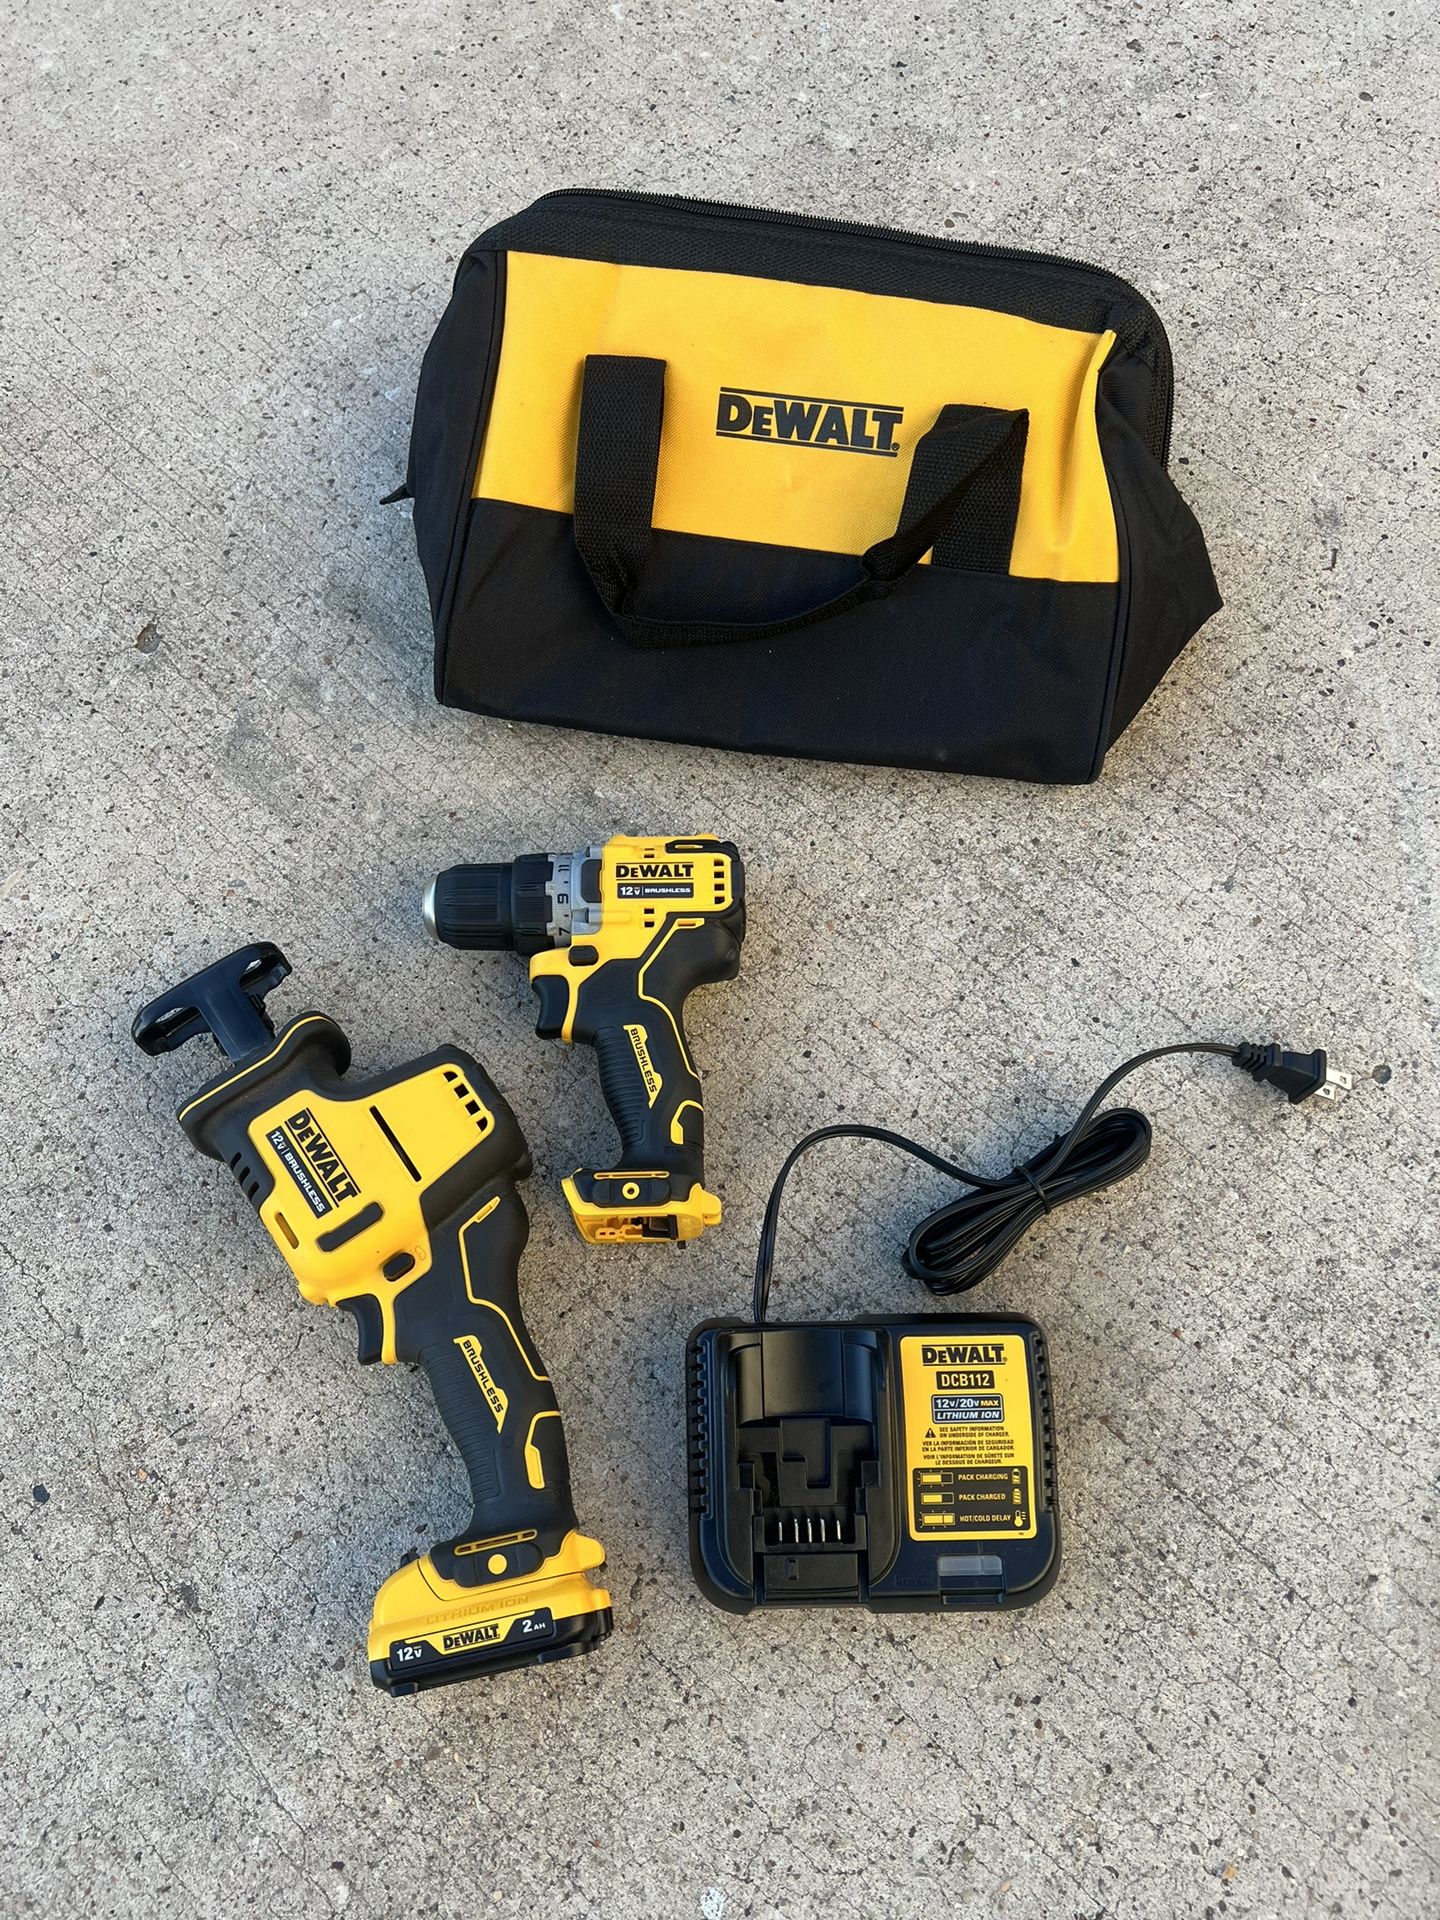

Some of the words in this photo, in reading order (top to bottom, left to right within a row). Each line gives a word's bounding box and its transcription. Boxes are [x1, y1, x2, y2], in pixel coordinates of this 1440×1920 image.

[630, 1028, 657, 1093] BRUSHLESS
[284, 1152, 326, 1213] BRUSHLESS
[463, 1340, 504, 1413] BRUSHLESS
[941, 1374, 990, 1387] DCB112
[937, 1411, 979, 1420] LITHIUM
[981, 1411, 1000, 1419] ION
[958, 1473, 975, 1481] PACK
[975, 1472, 1009, 1480] CHARGING
[958, 1493, 976, 1501] PACK
[976, 1492, 1006, 1500] CHARGED
[425, 1602, 495, 1625] LITHIUM
[499, 1595, 529, 1609] ION
